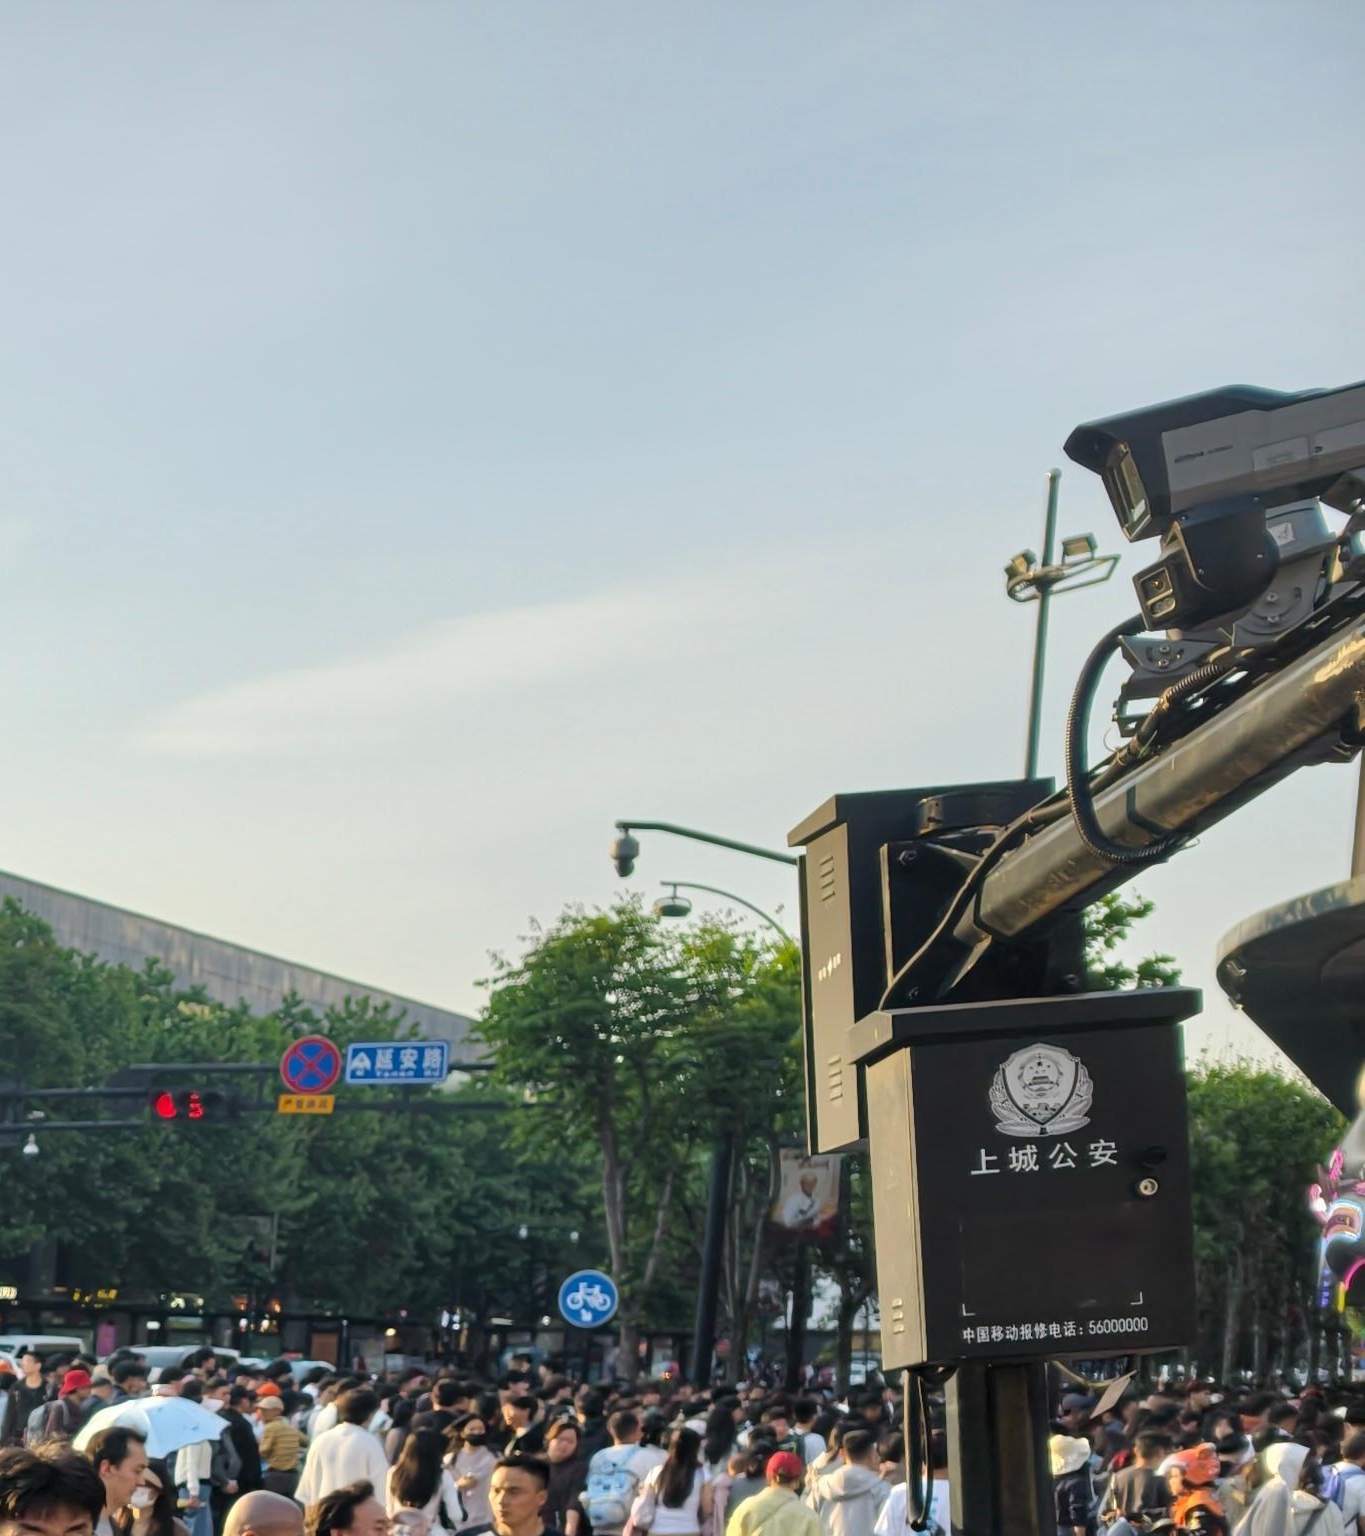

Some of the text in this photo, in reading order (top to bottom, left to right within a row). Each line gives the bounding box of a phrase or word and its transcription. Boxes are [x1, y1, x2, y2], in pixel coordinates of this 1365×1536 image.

[375, 1048, 442, 1070] 延安路
[971, 1139, 1118, 1175] 上城公安
